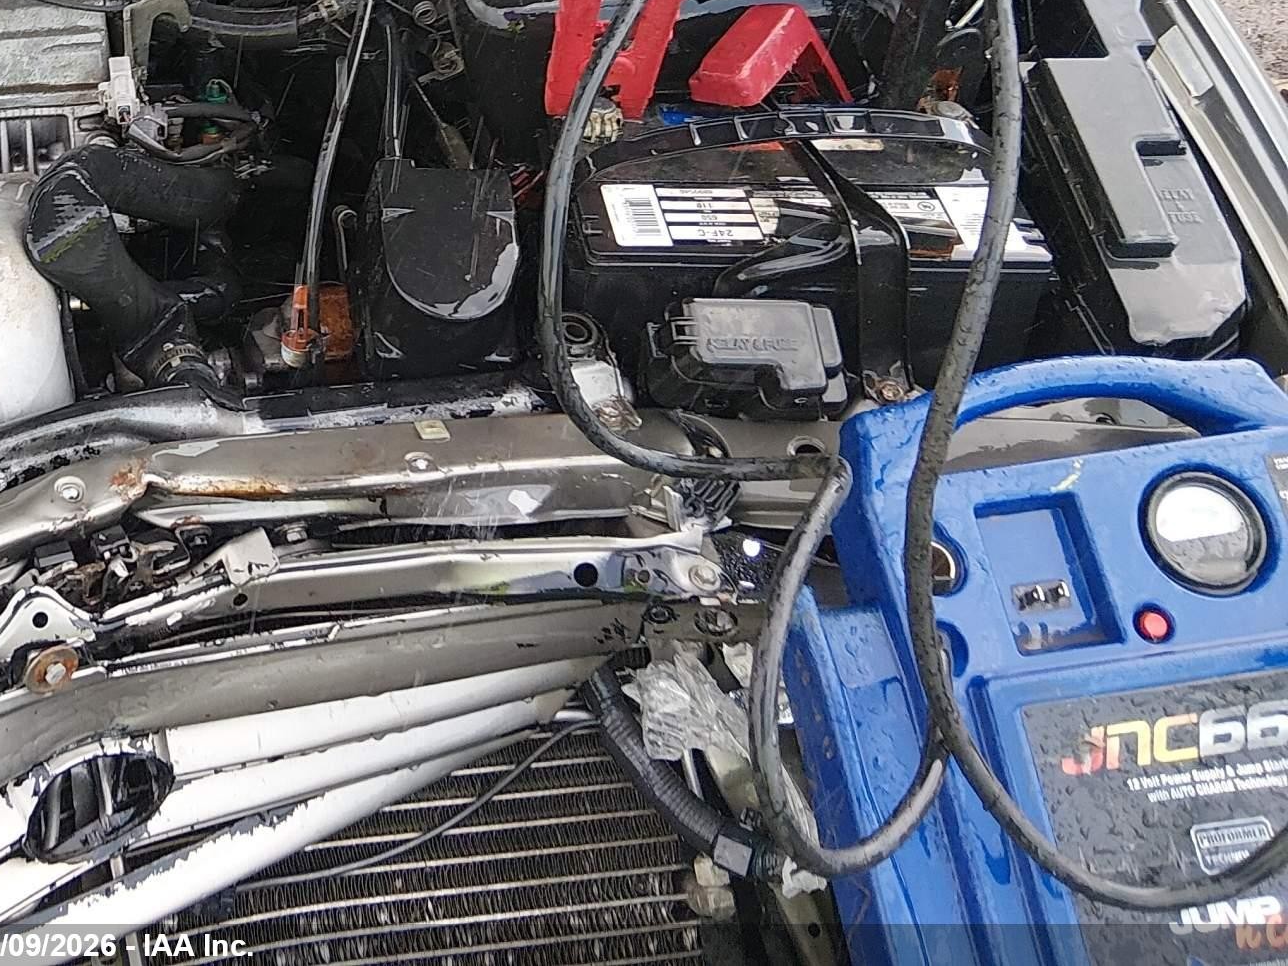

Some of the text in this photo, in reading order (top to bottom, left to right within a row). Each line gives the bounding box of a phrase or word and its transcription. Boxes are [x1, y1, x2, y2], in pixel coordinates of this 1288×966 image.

[1140, 775, 1161, 789] Volt
[1160, 772, 1192, 786] Power
[1192, 767, 1226, 782] Supply
[1236, 762, 1263, 776] Jump
[1147, 789, 1171, 803] with
[1170, 785, 1196, 800] AUTO
[1195, 780, 1235, 796] CHARGE
[1169, 895, 1281, 935] JUMP
